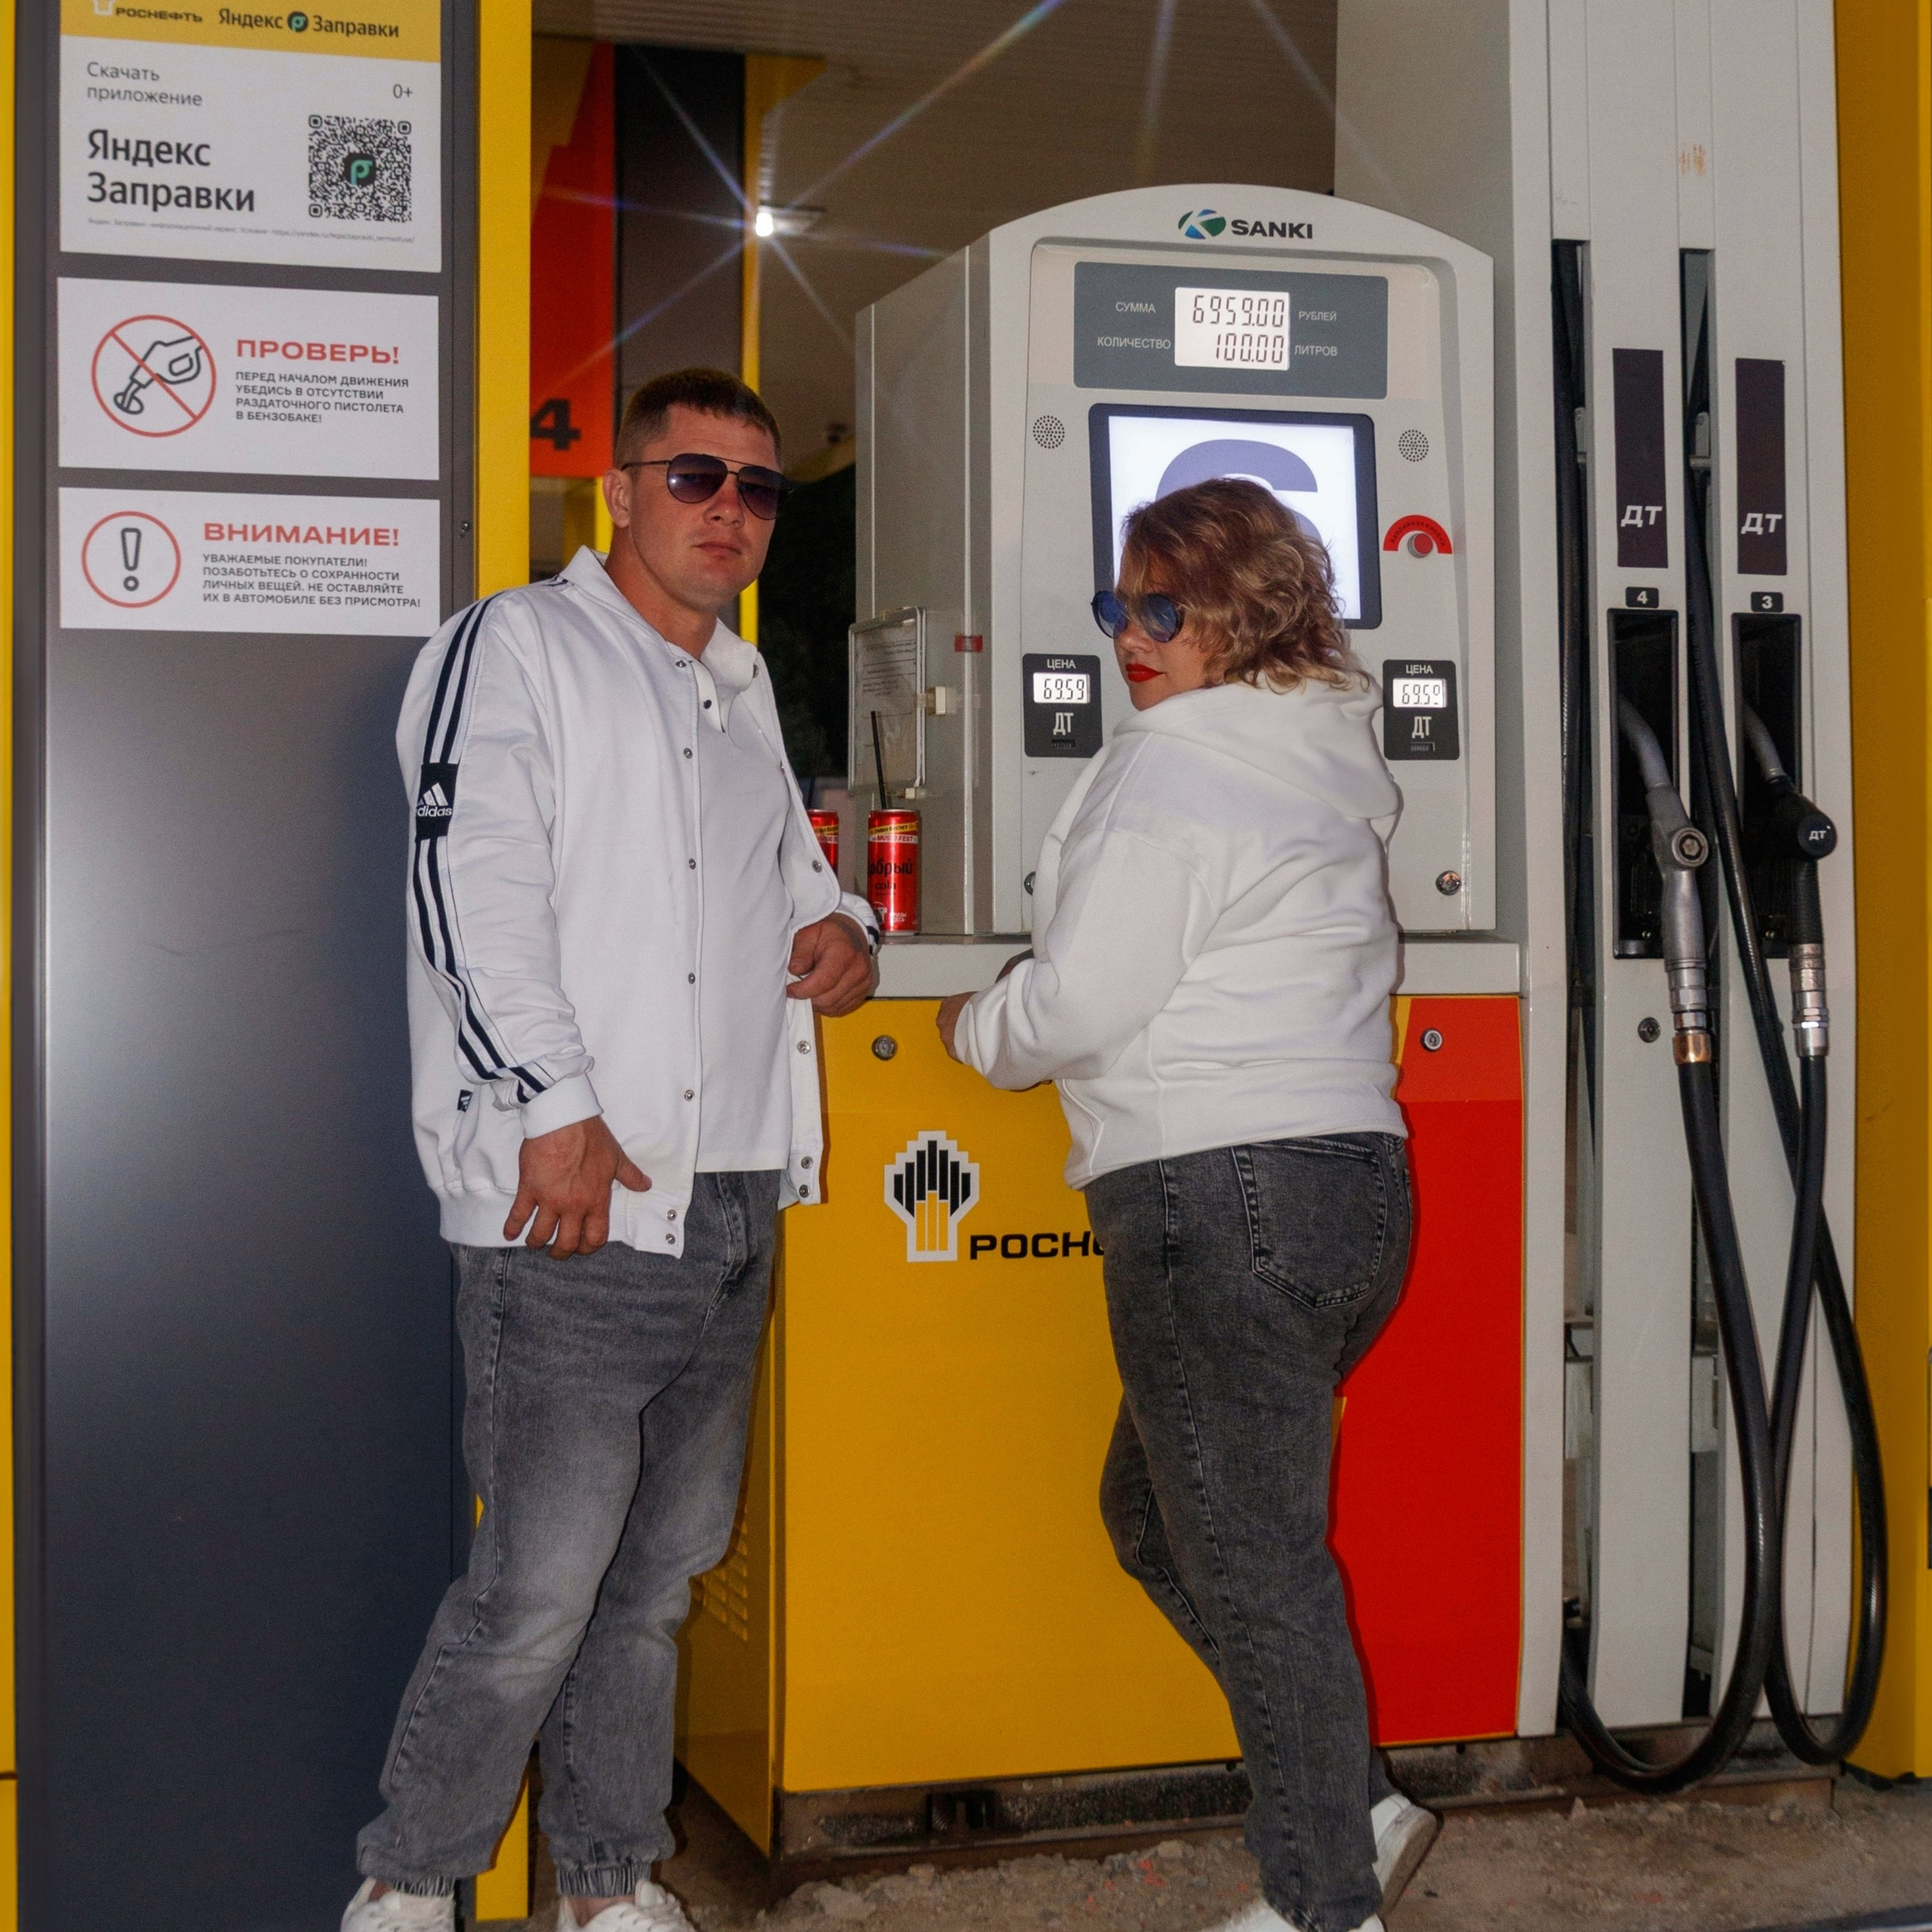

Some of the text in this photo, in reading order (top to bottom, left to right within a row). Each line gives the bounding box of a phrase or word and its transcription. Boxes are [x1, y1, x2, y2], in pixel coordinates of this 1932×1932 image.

[115, 7, 202, 23] РОСНЕФТЬ
[218, 8, 400, 38] Яндекс Заправки
[87, 62, 160, 82] Скачать
[87, 85, 202, 106] приложение
[392, 83, 414, 99] 0+
[87, 129, 211, 167] Яндекс
[87, 171, 255, 212] Заправки
[1231, 220, 1313, 239] SANKI
[1115, 302, 1155, 313] СУММА
[1192, 295, 1284, 328] 6959.00
[1299, 311, 1337, 321] РУБЛЕЙ
[1097, 337, 1171, 349] КОЛИЧЕСТВО
[1216, 333, 1284, 363] 100.00
[1294, 345, 1337, 357] ЛИТРОВ
[236, 340, 399, 364] ПРОВЕРЬ!
[235, 372, 409, 387] ПЕРЕД НАЧАЛОМ ДВИЖЕНИЯ
[235, 385, 384, 399] УБЕДИСЬ В ОТСУТСТВИИ
[235, 398, 405, 413] РАЗДАТОЧНОГО ПИСТОЛЕТА
[235, 411, 322, 423] В БЕНЗОБАКЕ!
[530, 398, 581, 450] 4
[1620, 505, 1663, 528] ДТ
[1740, 512, 1783, 535] ДТ
[204, 522, 399, 546] ВНИМАНИЕ!
[203, 554, 368, 568] УВАЖАЕМЫЕ ПОКУПАТЕЛИ!
[202, 568, 400, 581] ПОЗАБОТЬТЕСЬ О СОХРАННОСТИ
[202, 580, 404, 595] ЛИЧНЫХ ВЕЩЕЙ. НЕ ОСТАВЛЯЙТЕ
[202, 593, 421, 608] ИХ В АВТОМОБИЛЕ БЕЗ ПРИСМОТРА!
[1636, 590, 1648, 604] 4
[1761, 595, 1773, 609] 3
[1047, 659, 1076, 670] ЦЕНА
[1405, 665, 1433, 675] ЦЕНА
[1044, 678, 1084, 700] 69.59
[1053, 712, 1074, 736] ДТ
[1411, 716, 1432, 739] ДТ
[1809, 830, 1827, 841] ДТ
[868, 858, 913, 876] обрый
